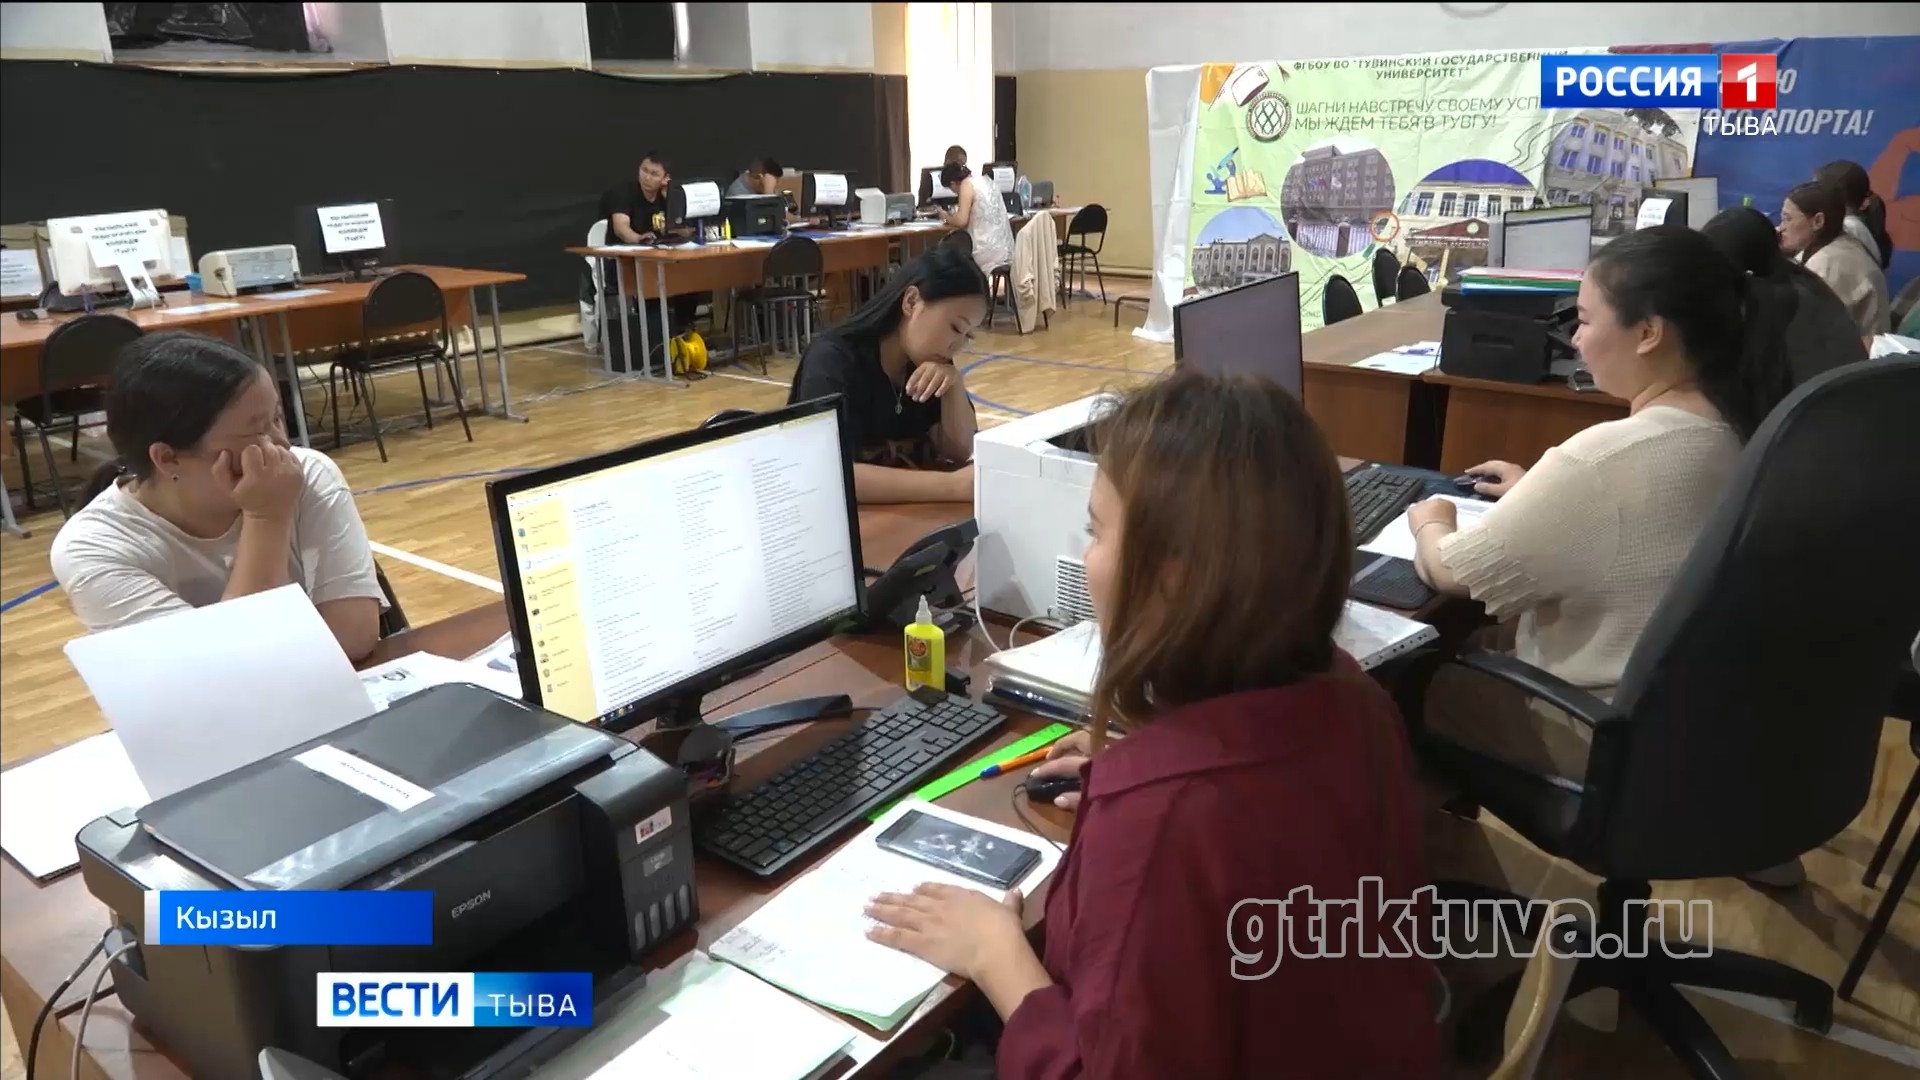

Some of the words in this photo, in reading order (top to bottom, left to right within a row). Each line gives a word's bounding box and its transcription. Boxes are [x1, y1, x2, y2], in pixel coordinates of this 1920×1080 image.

[1294, 61, 1331, 71] ФГБОУ
[1333, 60, 1349, 70] ВО
[1296, 101, 1345, 114] ШАГНИ
[1349, 99, 1435, 114] НАВСТРЕЧУ
[1438, 97, 1503, 112] СВОЕМУ
[1507, 96, 1540, 111] УСП
[1294, 116, 1321, 131] МЫ
[1325, 116, 1374, 132] ЖДЕМ
[1380, 115, 1420, 130] ТЕБЯ
[1424, 115, 1435, 130] В
[1441, 114, 1497, 130] ТУВГУ!
[1759, 109, 1875, 135] СПОРТА!
[451, 888, 491, 919] EPSON
